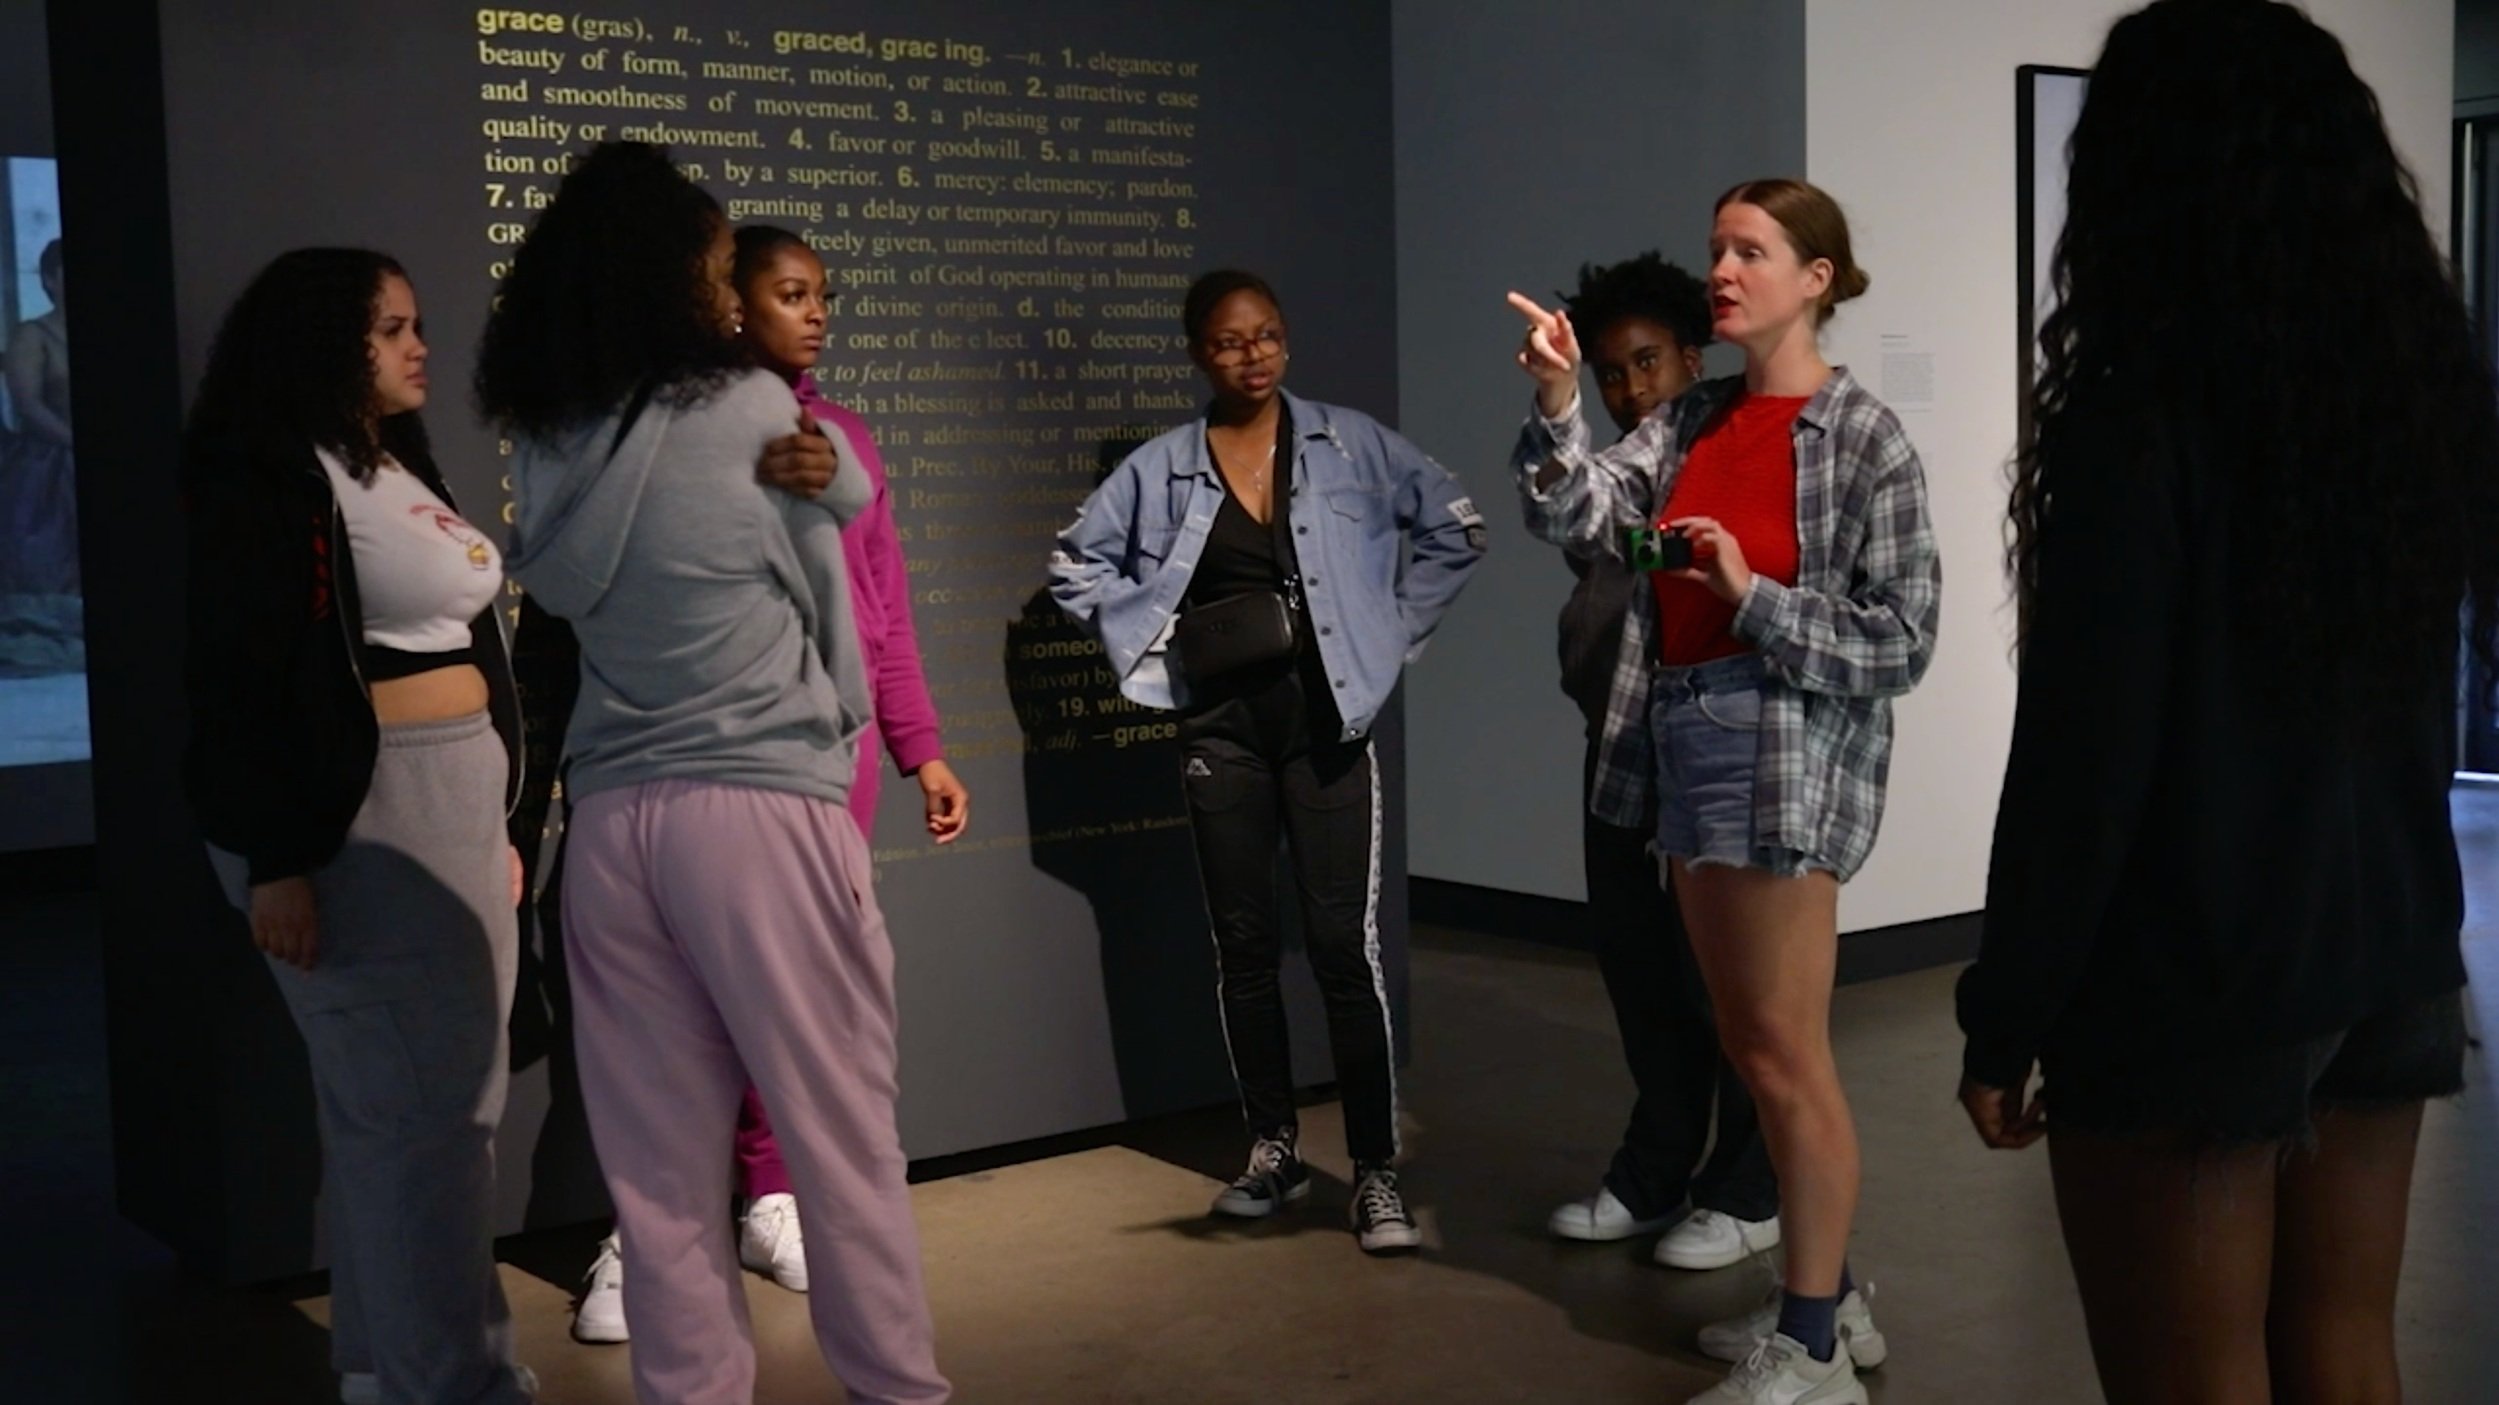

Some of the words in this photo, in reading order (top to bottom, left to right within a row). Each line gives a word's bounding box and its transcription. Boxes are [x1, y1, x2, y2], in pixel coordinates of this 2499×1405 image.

[477, 8, 564, 34] grace
[571, 13, 654, 43] (gras),
[774, 30, 873, 59] graced,
[1061, 48, 1081, 70] 1.
[1088, 51, 1172, 78] elegance
[1179, 60, 1198, 77] or
[479, 41, 564, 74] beauty
[581, 48, 607, 71] of
[623, 51, 687, 78] form,
[703, 59, 796, 85] manner,
[810, 66, 894, 90] motion,
[908, 75, 930, 90] or
[943, 74, 1012, 97] action.
[1026, 78, 1047, 97] 2.
[1055, 83, 1147, 105] attractive
[1157, 91, 1199, 108] ease
[481, 80, 528, 103] and
[544, 85, 687, 111] smoothness
[709, 92, 737, 113] of
[756, 98, 879, 122] movement.
[894, 101, 916, 122] 3.
[931, 109, 943, 123] a
[963, 107, 1048, 135] pleasing
[1060, 116, 1082, 131] or
[1106, 116, 1195, 138] attractive
[483, 116, 571, 144] quality
[580, 124, 606, 141] or
[621, 124, 766, 149] endowment.
[789, 128, 812, 149] 4.
[829, 134, 886, 154] favor
[893, 138, 916, 154] or
[928, 137, 1027, 163] goodwill.
[1040, 141, 1061, 161] 5.
[1069, 148, 1080, 163] a
[1091, 145, 1192, 168] manifesta-
[485, 151, 534, 173] tion
[543, 152, 572, 174] of
[725, 159, 753, 187] by
[761, 166, 773, 182] a
[787, 164, 882, 189] superior.
[897, 167, 919, 187] 6.
[1127, 178, 1198, 200] pardon.
[486, 184, 513, 208] 7.
[729, 196, 823, 221] granting
[837, 203, 848, 217] a
[863, 199, 919, 228] delay
[927, 205, 949, 221] or
[957, 206, 1060, 231] temporary
[1067, 205, 1165, 232] immunity.
[1176, 209, 1197, 228] 8.
[872, 234, 937, 257] given,
[944, 237, 1048, 257] unmerited
[1055, 237, 1105, 257] favor
[1112, 239, 1146, 258] and
[1153, 239, 1194, 259] love
[841, 265, 897, 288] spirit
[910, 266, 932, 285] of
[939, 266, 982, 287] God
[989, 267, 1086, 291] operating
[1091, 269, 1109, 287] in
[1116, 269, 1190, 289] humans
[856, 297, 923, 317] divine
[936, 298, 1004, 322] origin.
[1018, 298, 1039, 318] d.
[1055, 299, 1084, 318] the
[849, 334, 887, 349] one
[895, 329, 920, 349] of
[931, 330, 962, 348] the
[1043, 330, 1077, 348] 10.
[1091, 330, 1169, 352] decency
[835, 364, 856, 382] to
[858, 360, 902, 386] feel
[1016, 361, 1048, 380] 11.
[1054, 366, 1067, 380] a
[1078, 361, 1128, 380] short
[1133, 364, 1194, 384] prayer
[876, 399, 887, 413] a
[896, 392, 978, 415] blessing
[1017, 392, 1073, 411] asked
[1086, 391, 1121, 410] and
[1133, 390, 1195, 409] thanks
[892, 425, 910, 444] in
[923, 421, 1034, 446] addressing
[1040, 427, 1060, 442] or
[1074, 421, 1171, 441] mentionin
[1020, 638, 1105, 660] someo
[1057, 696, 1091, 718] 19.
